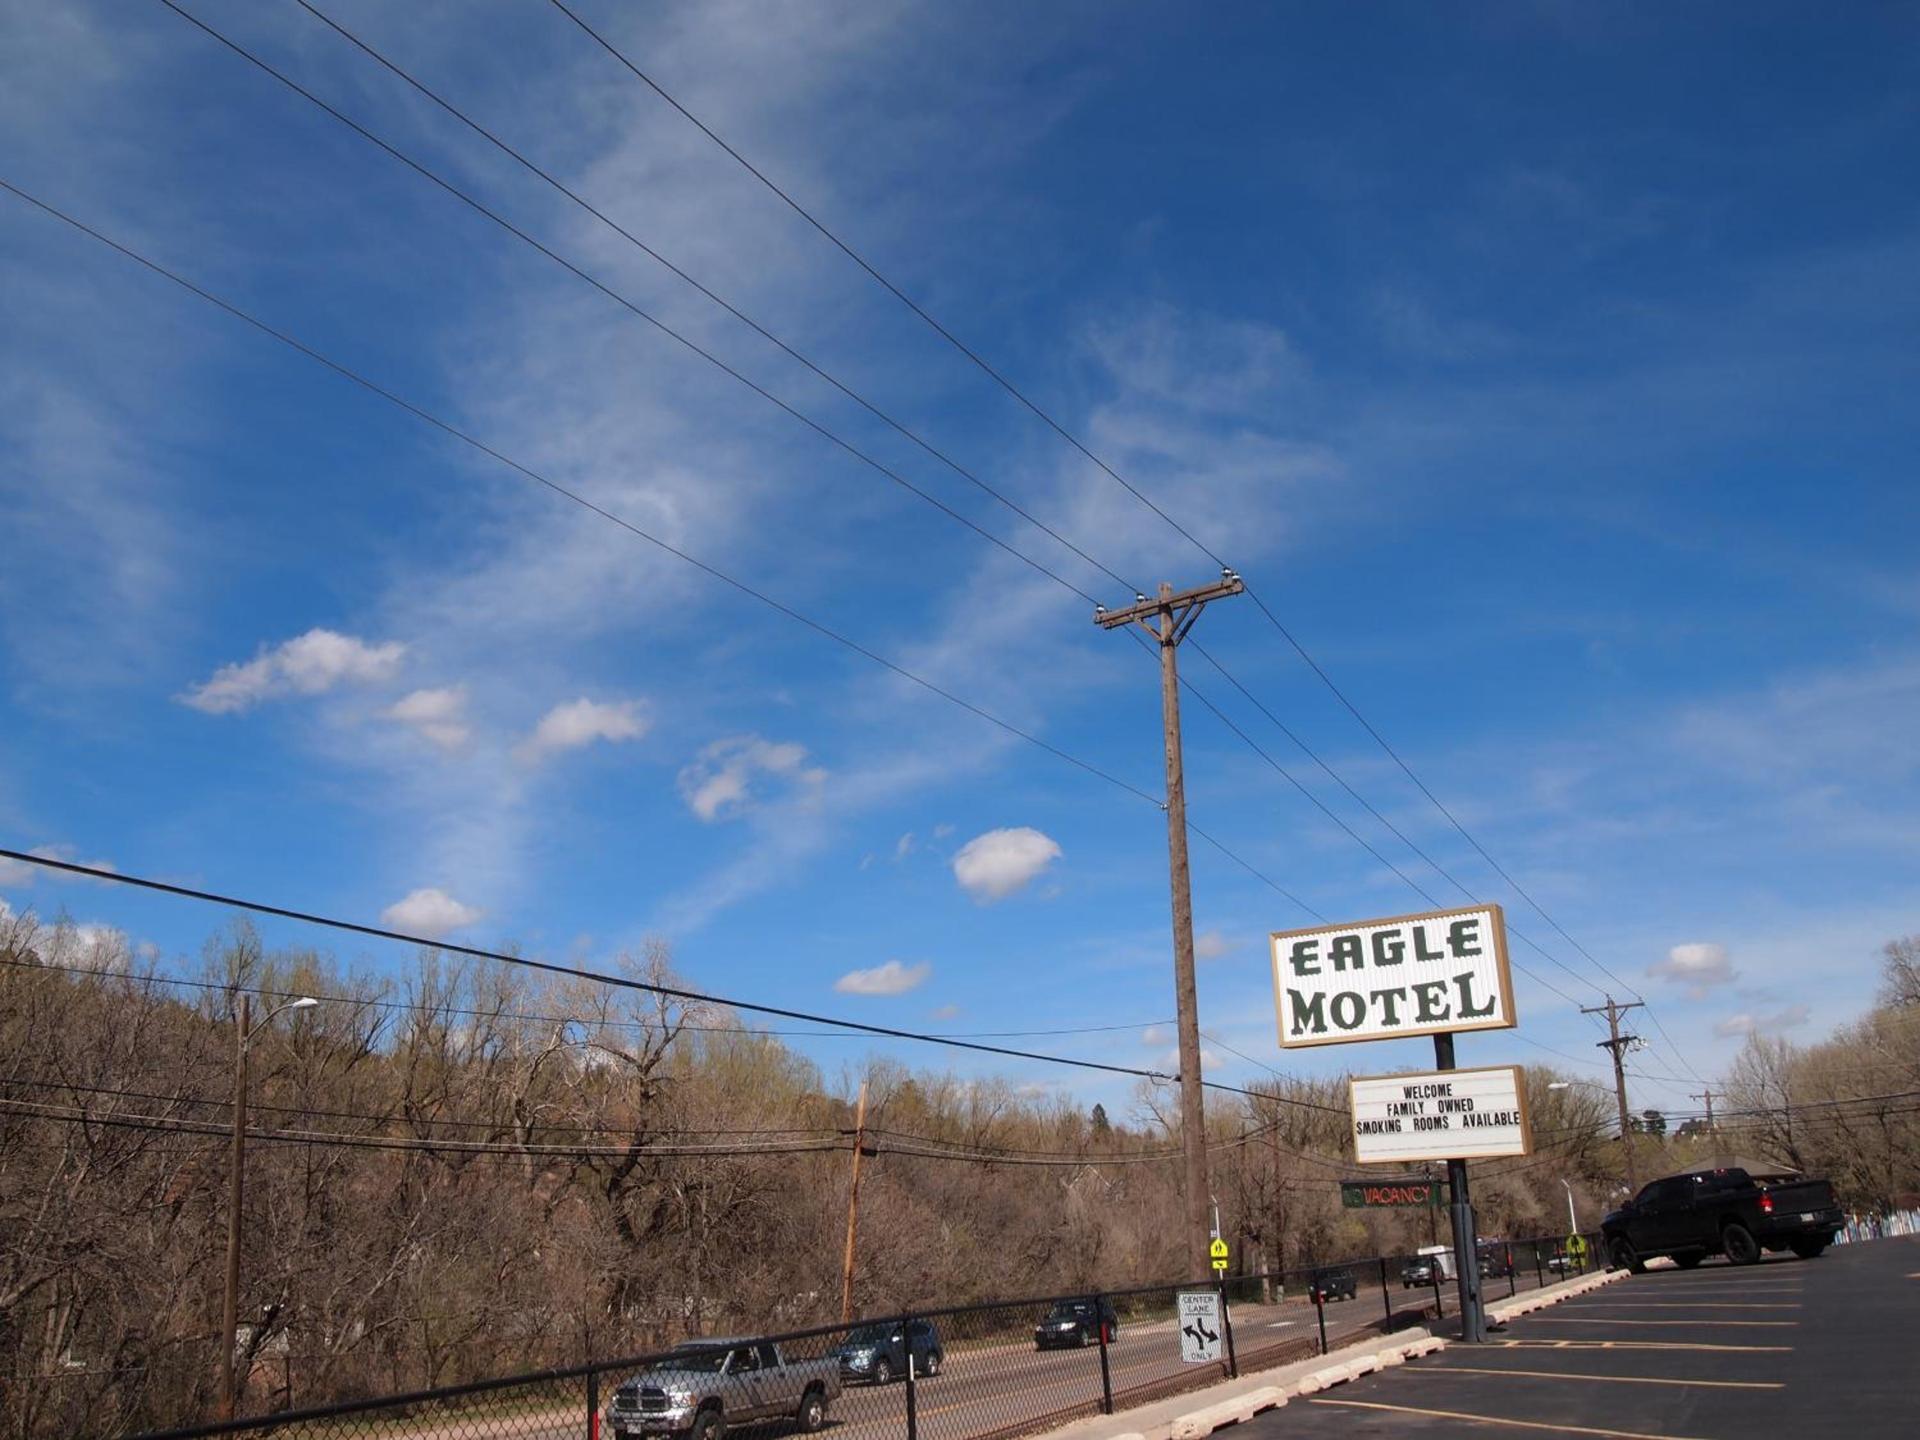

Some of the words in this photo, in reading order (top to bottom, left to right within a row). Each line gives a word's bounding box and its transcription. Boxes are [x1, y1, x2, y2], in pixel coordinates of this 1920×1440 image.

[1289, 919, 1482, 976] EAGLE
[1287, 971, 1496, 1035] MOTEL
[1403, 1083, 1453, 1099] WELCOME
[1387, 1102, 1425, 1117] FAMILY
[1438, 1098, 1474, 1113] OWNED
[1356, 1119, 1401, 1135] SMOKING
[1413, 1116, 1449, 1131] ROOMS
[1462, 1111, 1520, 1128] AVAILABLE
[1363, 1186, 1430, 1204] VACANCY
[1183, 1296, 1214, 1304] CENTER
[1191, 1352, 1213, 1360] ONLY
